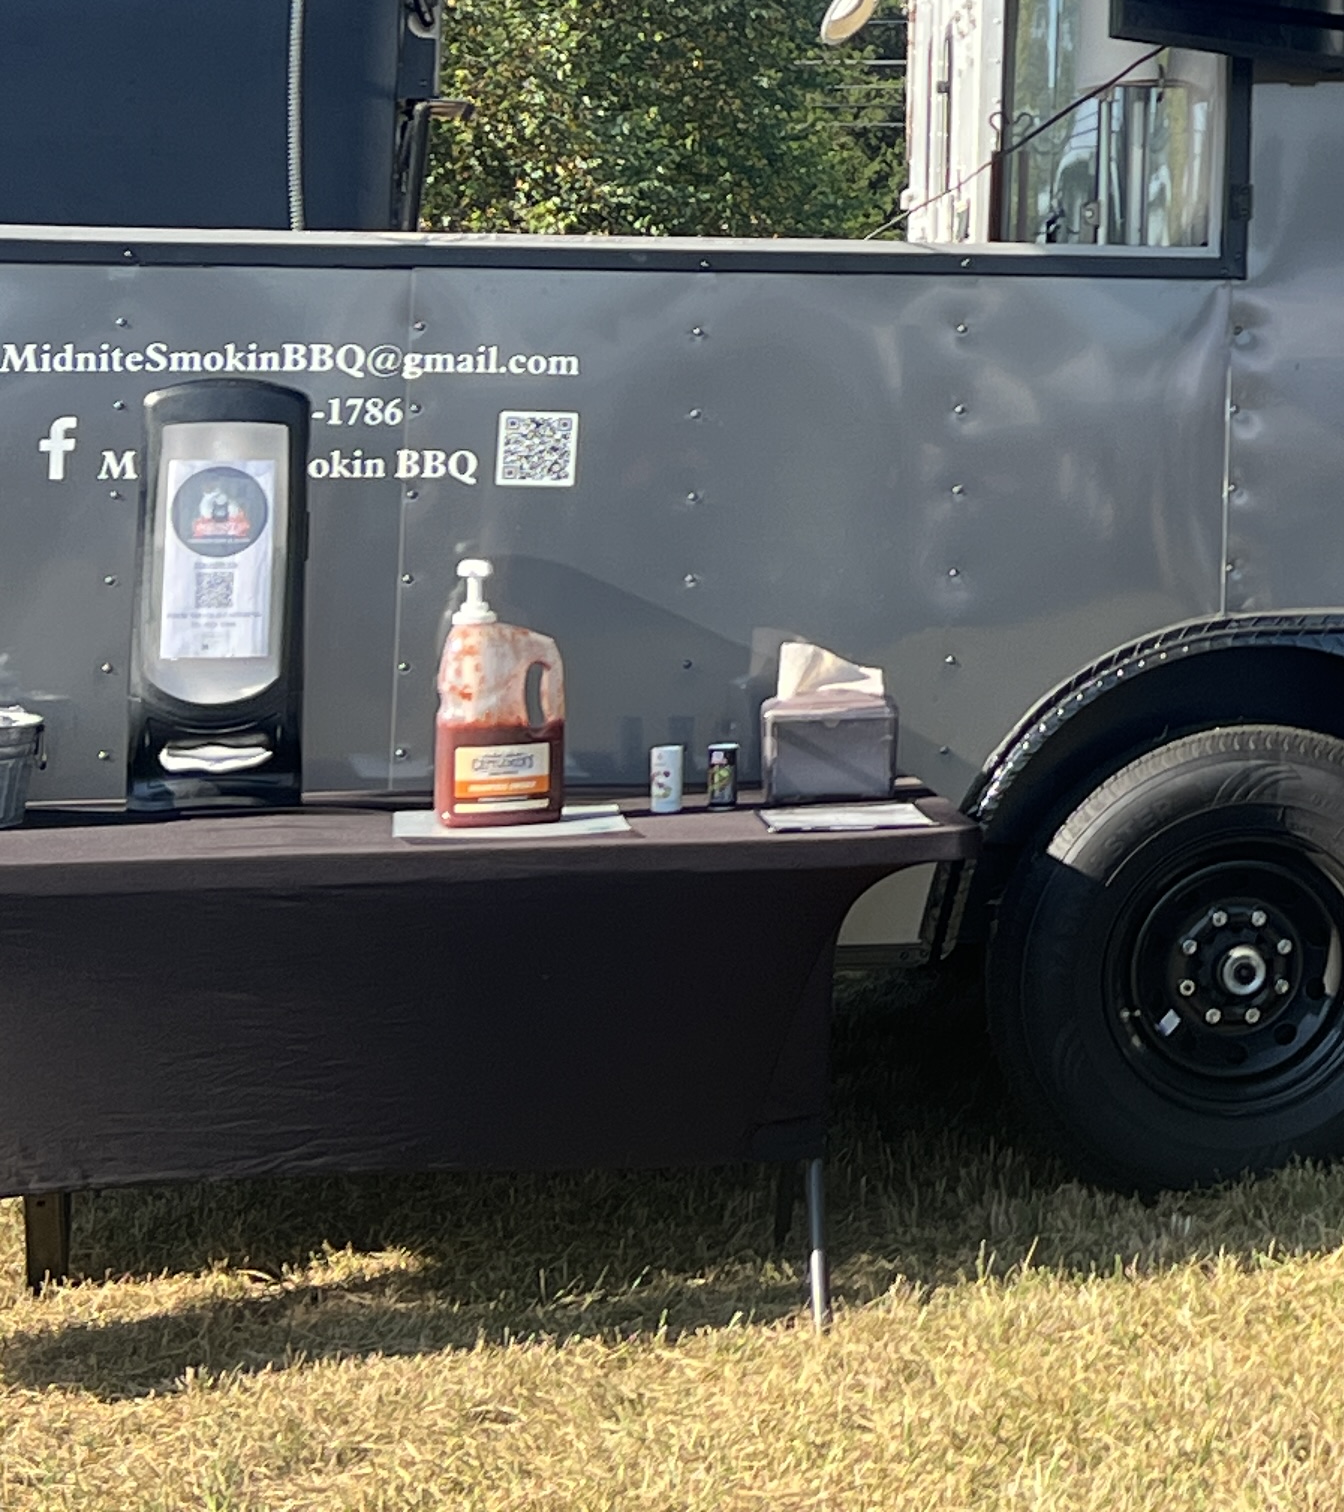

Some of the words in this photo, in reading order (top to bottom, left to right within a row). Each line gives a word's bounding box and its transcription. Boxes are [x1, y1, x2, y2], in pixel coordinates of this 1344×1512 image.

[0, 342, 580, 380] MidniteSmokinBBQ@gmail.com
[307, 449, 385, 479] okin
[394, 449, 478, 485] BBQ
